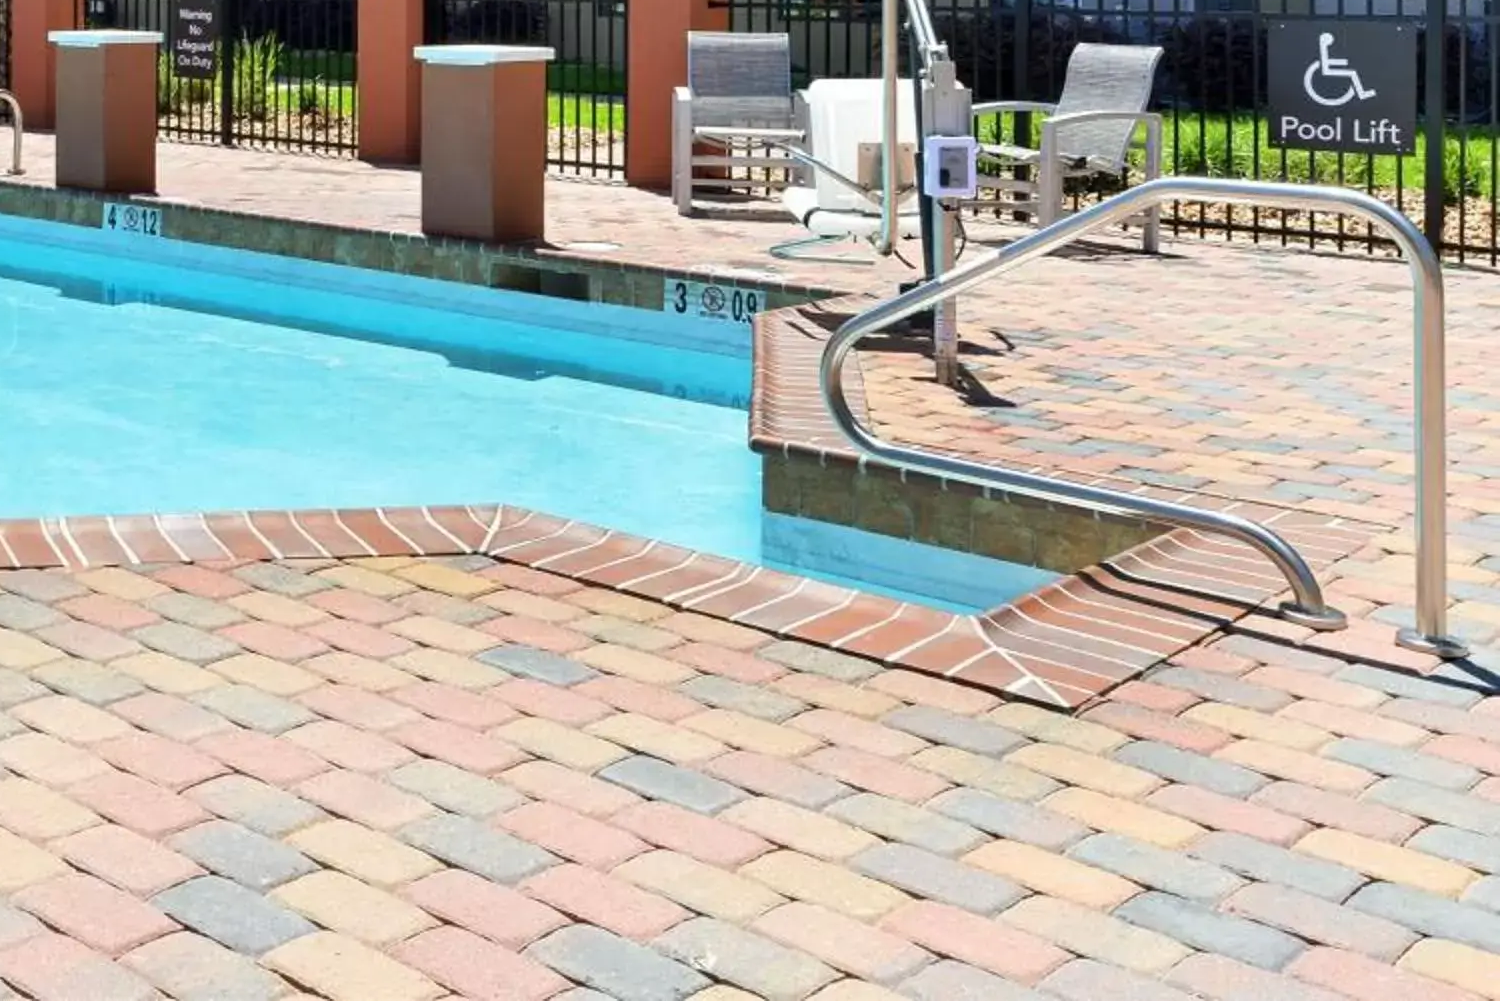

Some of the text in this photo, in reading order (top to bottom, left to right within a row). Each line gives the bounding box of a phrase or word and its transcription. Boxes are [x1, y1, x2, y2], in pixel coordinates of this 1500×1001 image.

[179, 8, 213, 23] Warning
[189, 24, 202, 36] No
[177, 39, 214, 53] Lifeguard
[178, 54, 212, 70] On Duty
[1281, 116, 1401, 144] Pool Lift
[107, 204, 117, 230] 4
[674, 282, 757, 324] 3 0.9
